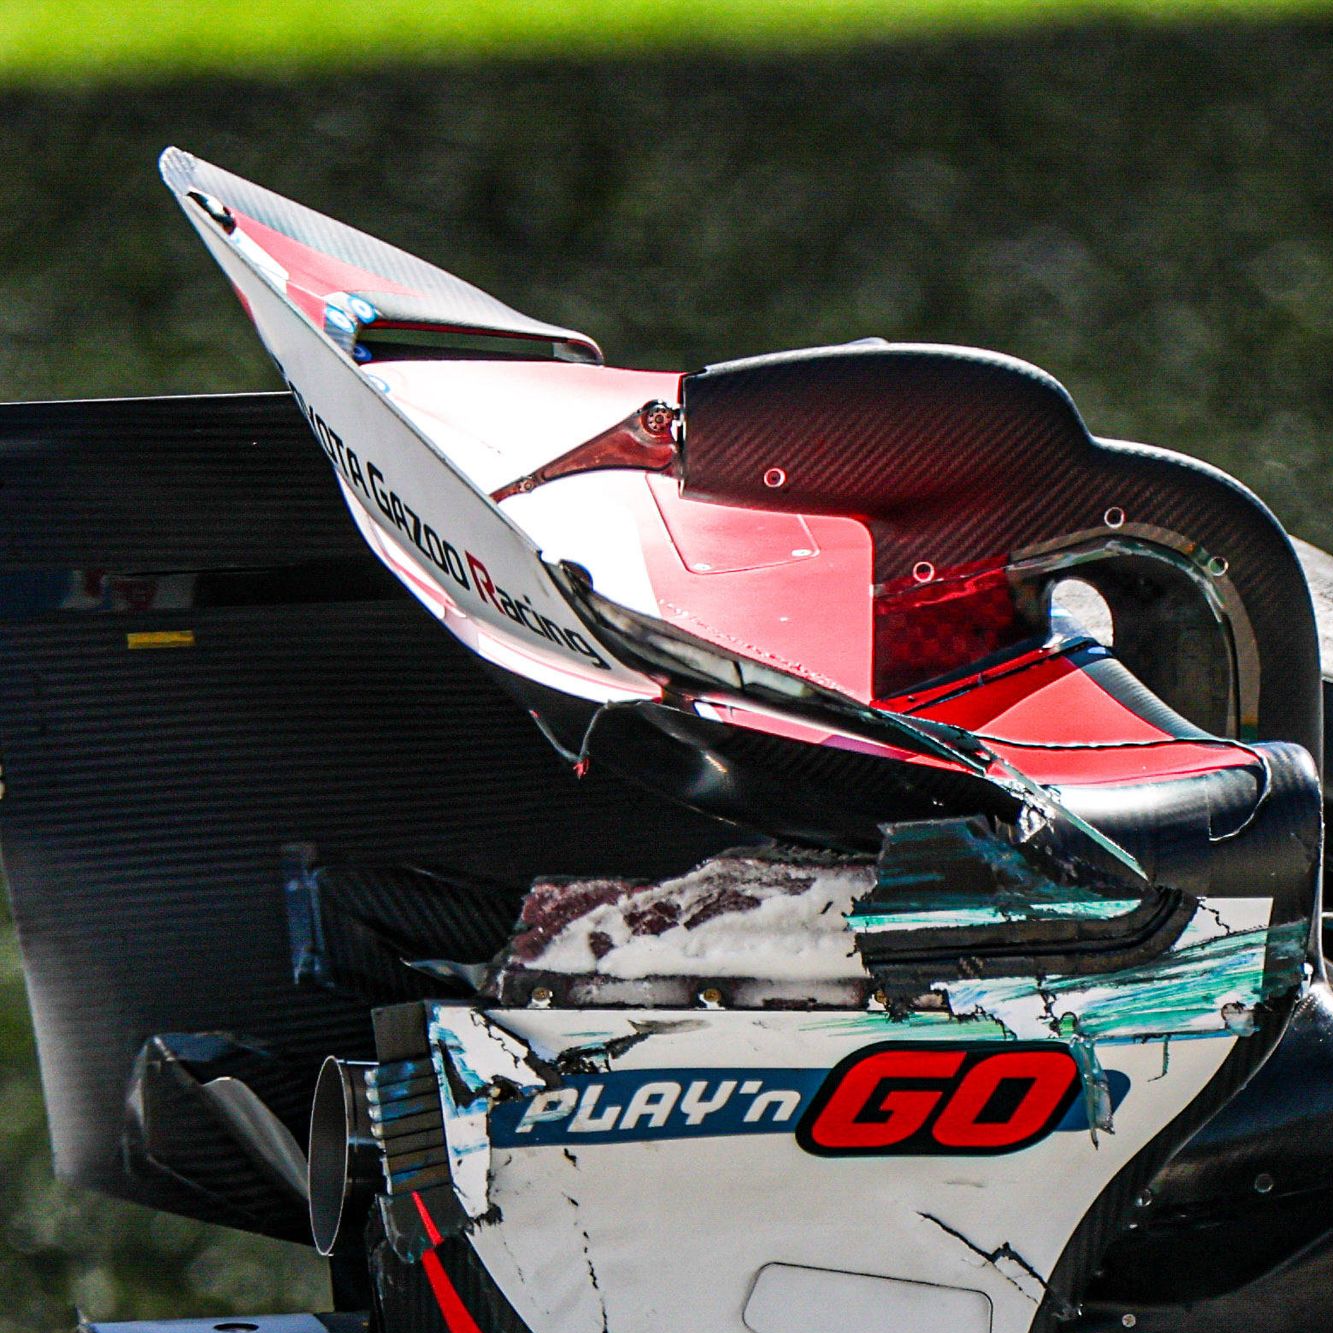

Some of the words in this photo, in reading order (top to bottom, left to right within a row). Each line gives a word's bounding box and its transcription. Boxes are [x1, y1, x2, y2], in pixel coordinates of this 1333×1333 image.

[464, 549, 612, 671] Racing
[515, 1079, 801, 1135] PLAY'n
[811, 1050, 1078, 1148] GO
